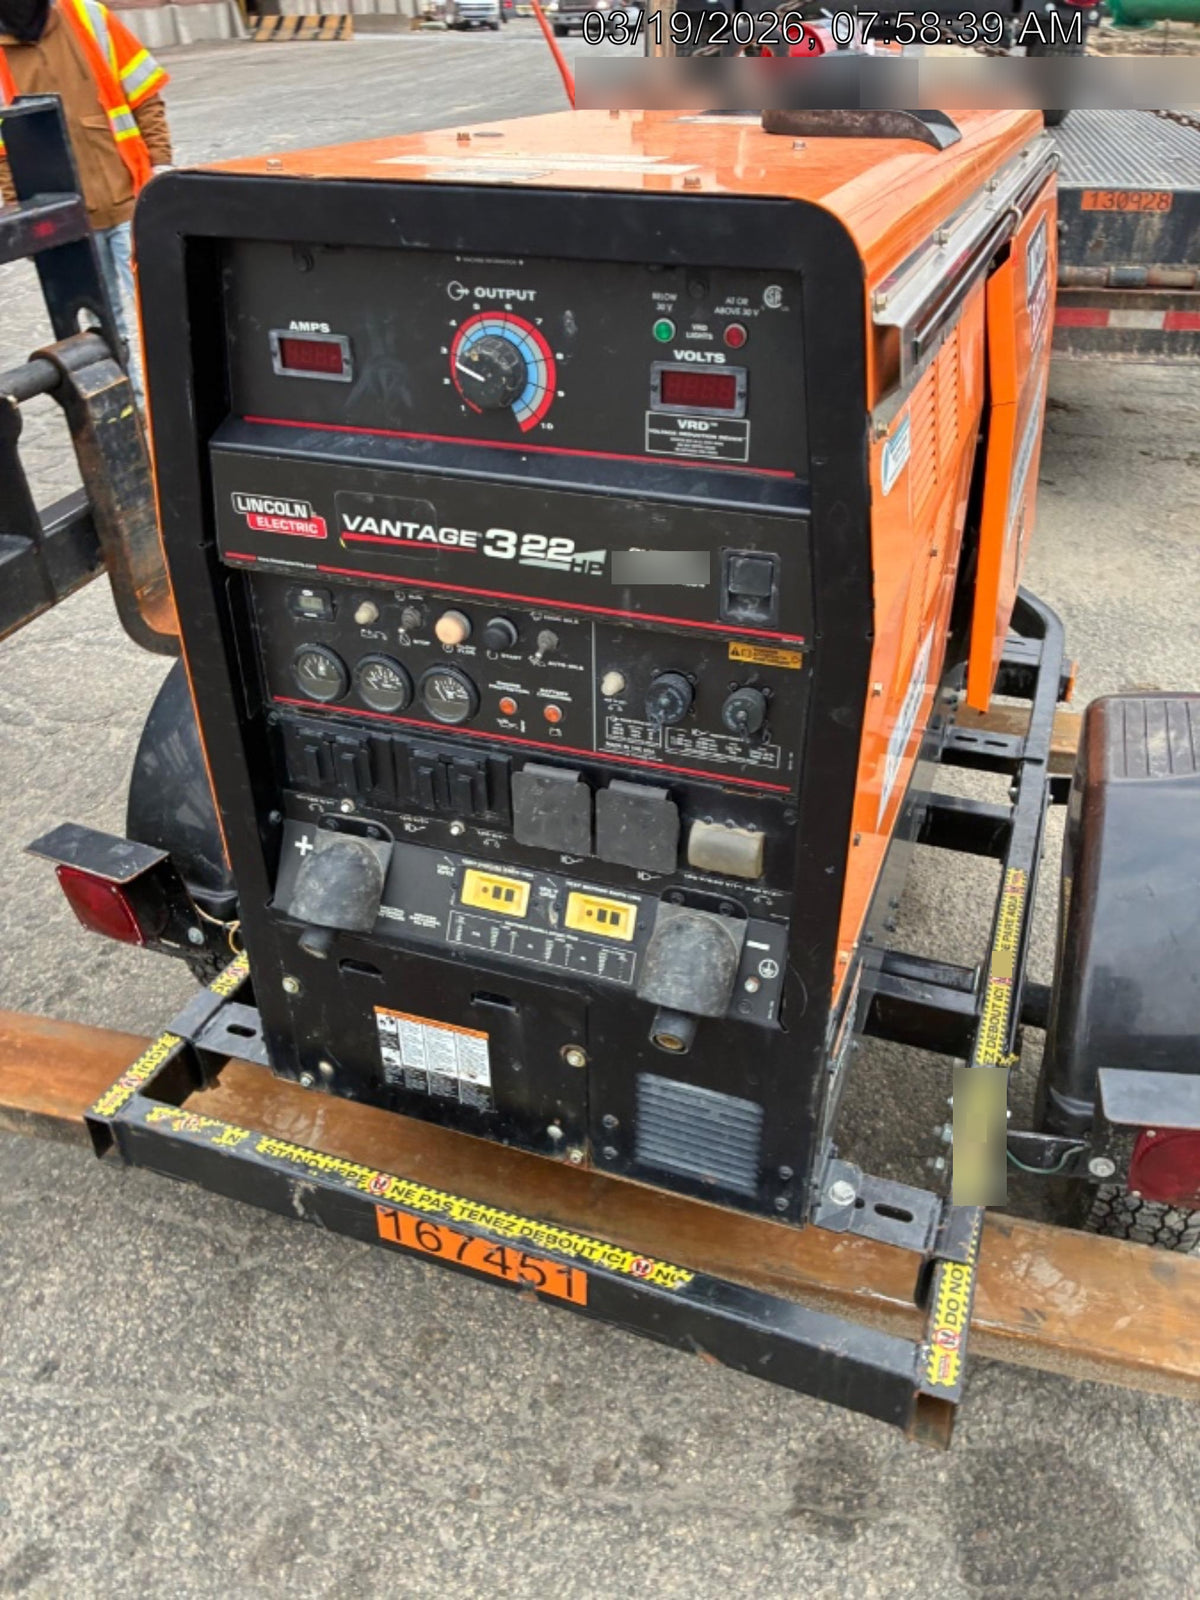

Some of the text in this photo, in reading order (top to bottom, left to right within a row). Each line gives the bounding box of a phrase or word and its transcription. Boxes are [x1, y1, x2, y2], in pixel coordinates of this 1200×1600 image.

[1089, 191, 1170, 211] 130928
[473, 286, 537, 301] OUTPUT
[289, 320, 331, 334] AMPS
[673, 350, 727, 364] VOLTS
[237, 496, 308, 519] LINCOLN
[256, 516, 319, 535] ELECTRIC
[483, 528, 576, 563] 322
[985, 1003, 1002, 1049] DEBOUT
[391, 1184, 627, 1266] NE PAS TENEZ DEBOUT ICI
[384, 1210, 574, 1298] 167451
[944, 1265, 965, 1326] DO NO
